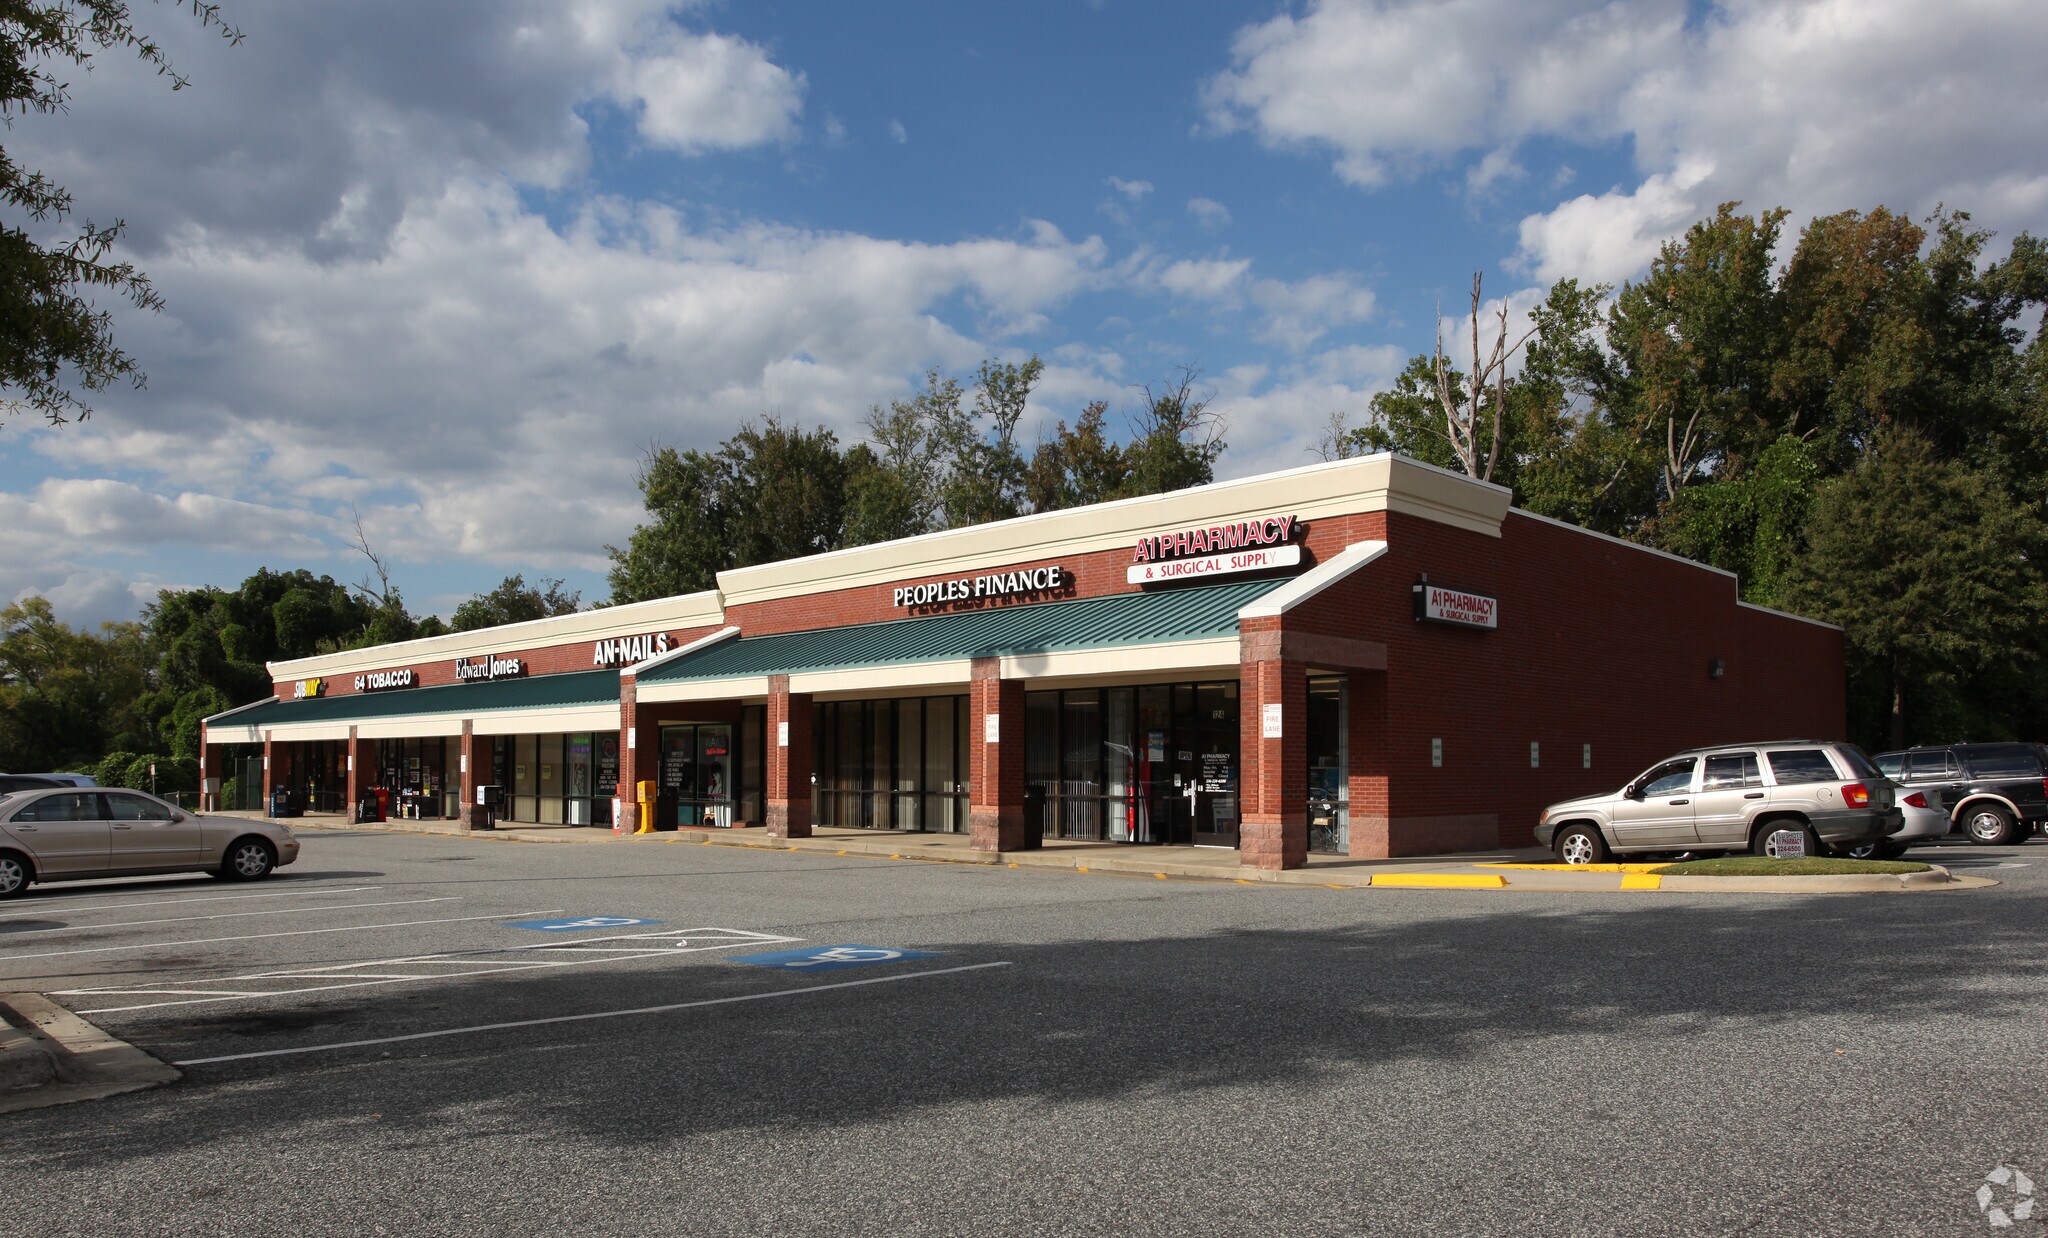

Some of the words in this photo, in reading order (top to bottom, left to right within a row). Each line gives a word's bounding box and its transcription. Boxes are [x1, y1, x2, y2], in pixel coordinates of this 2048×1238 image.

[1133, 535, 1156, 562] A1
[1159, 515, 1293, 559] PHARMACY
[1145, 567, 1154, 579] &
[1160, 559, 1222, 577] SURGICAL
[1231, 551, 1277, 569] SUPPLY
[893, 578, 970, 607] PEOPLES
[975, 566, 1061, 597] FINANCE
[1431, 589, 1442, 607] A1
[1443, 591, 1494, 615] PHARMACY
[1446, 609, 1471, 622] SURGICAL
[1472, 613, 1488, 624] SUPPLY
[594, 632, 668, 665] AN-NAILS
[354, 675, 365, 690] 64
[367, 669, 411, 689] TOBACCO
[455, 656, 489, 679] Edward
[488, 654, 520, 679] Jones
[294, 678, 321, 698] SUBWAY
